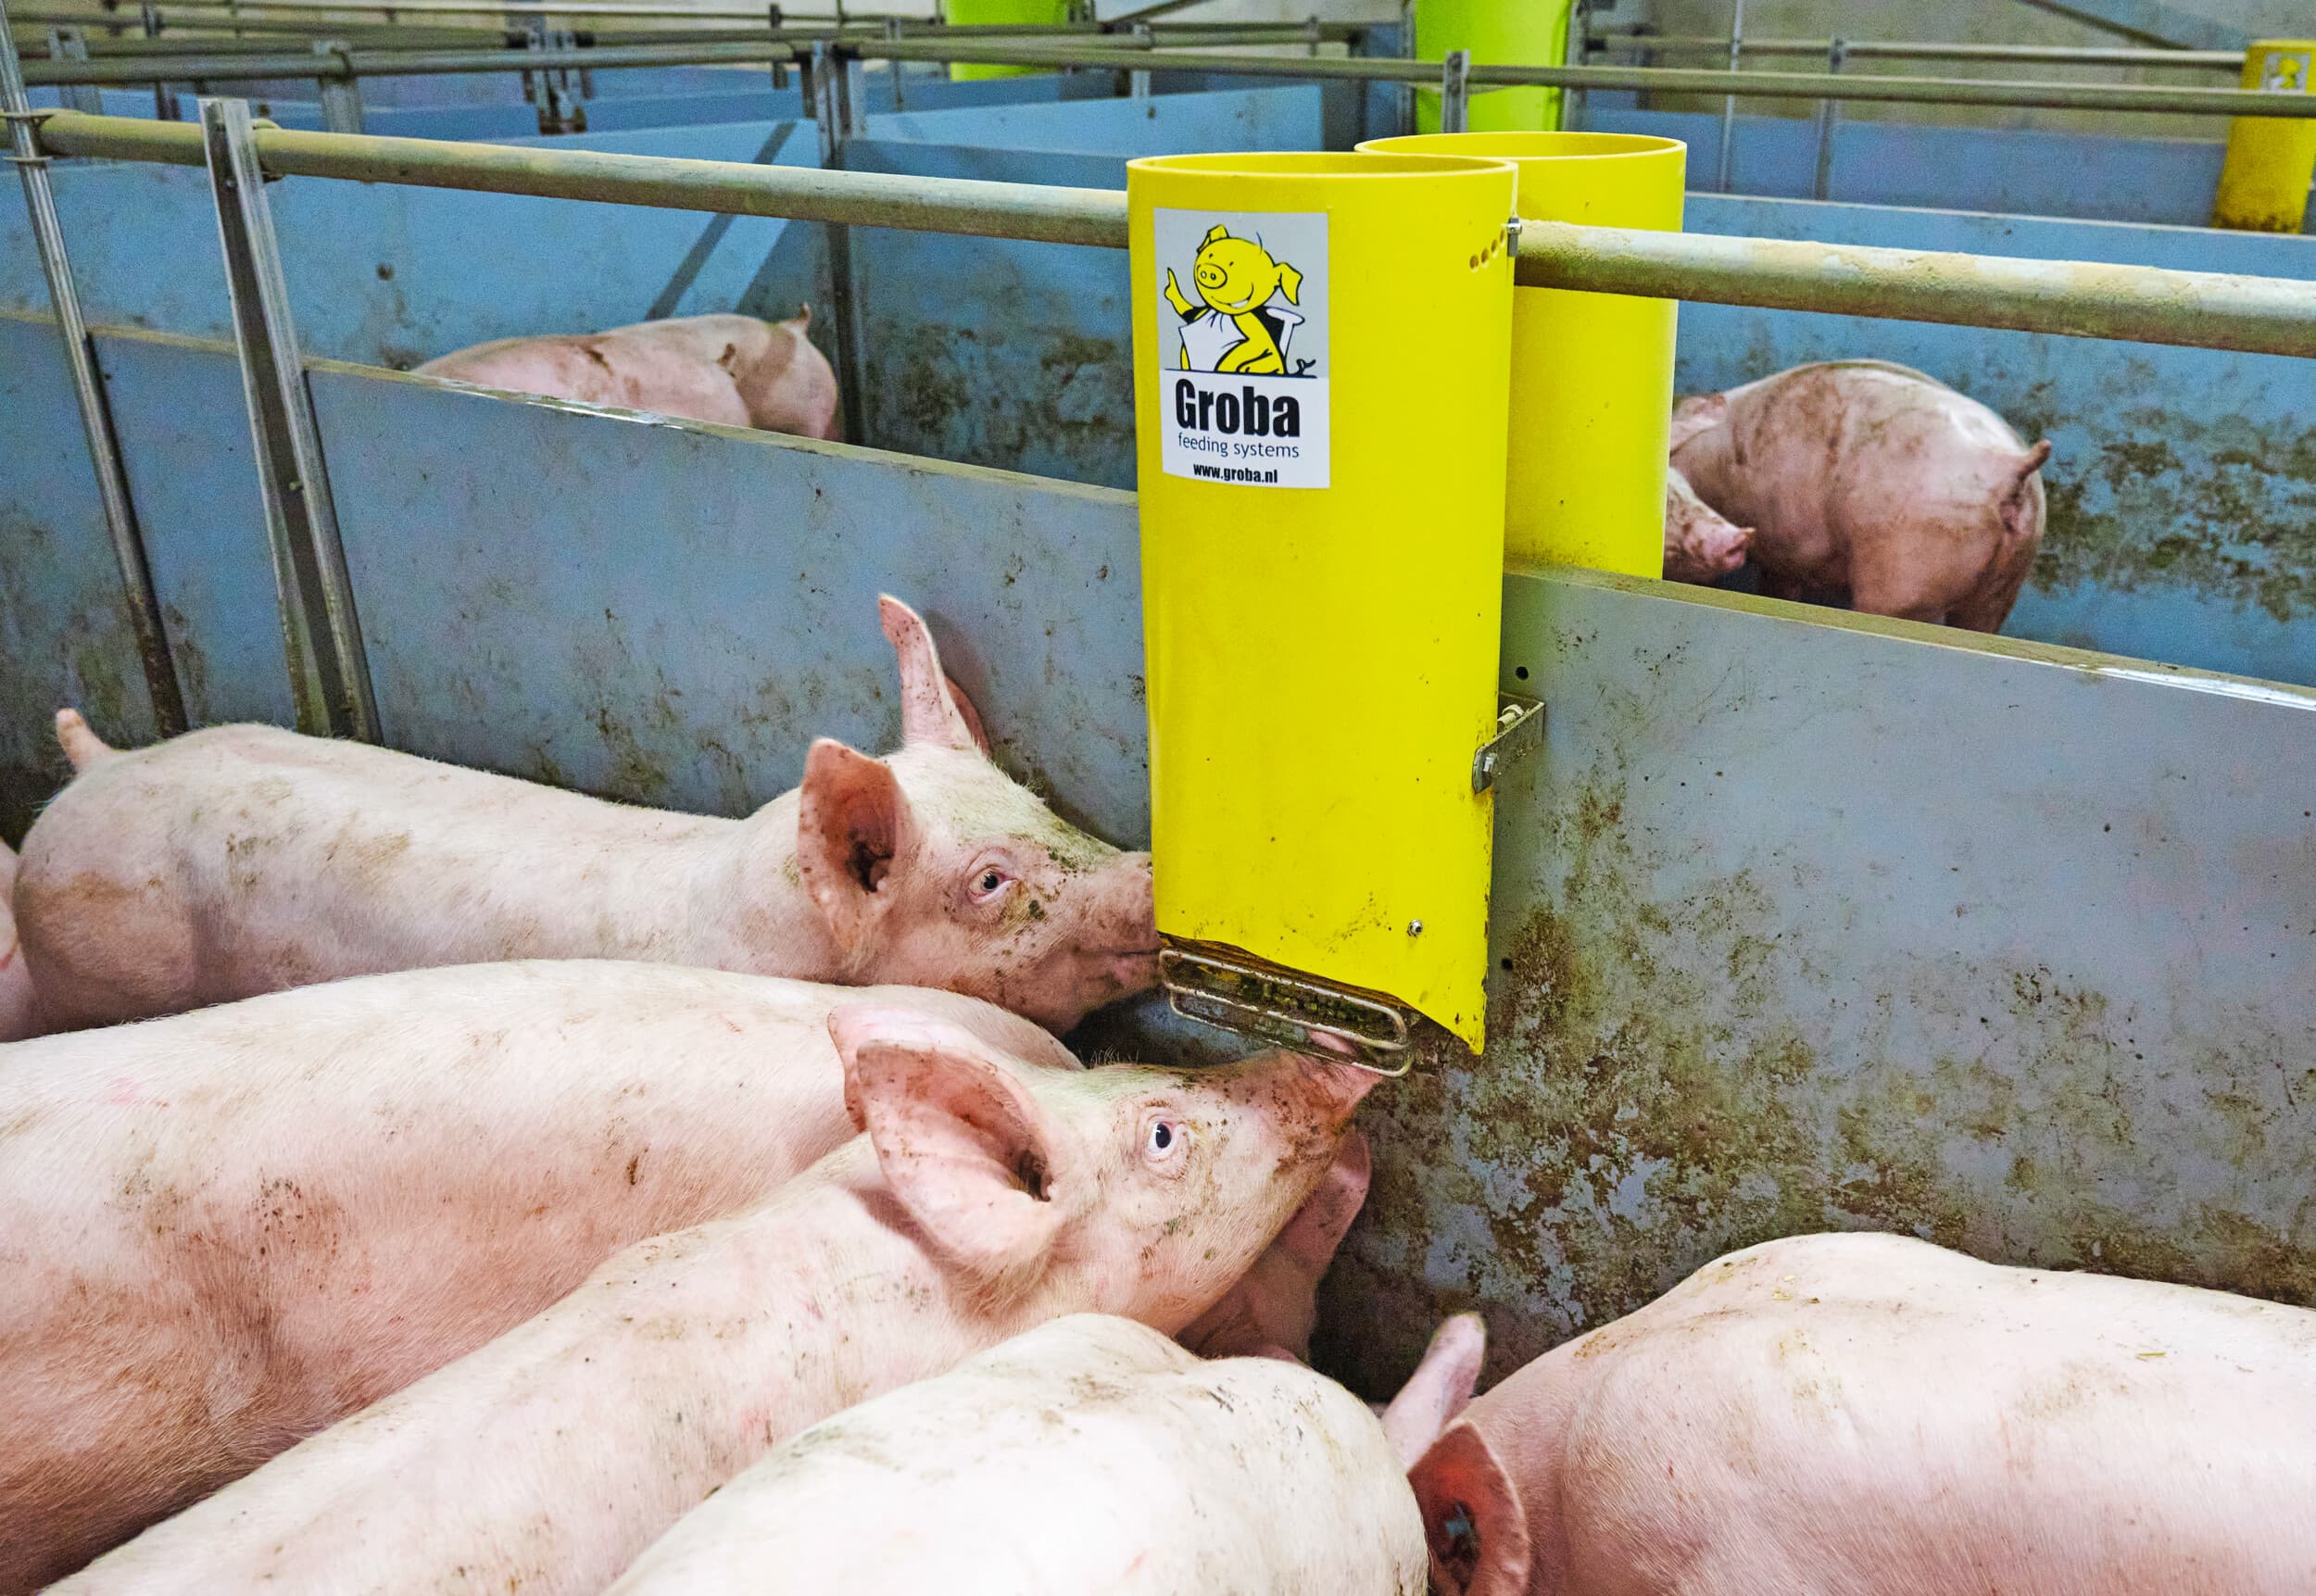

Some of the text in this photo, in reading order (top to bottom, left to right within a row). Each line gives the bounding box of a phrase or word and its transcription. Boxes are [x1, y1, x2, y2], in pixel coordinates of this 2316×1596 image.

[1176, 378, 1300, 437] Groba
[1177, 433, 1299, 459] feeding systems
[1193, 463, 1278, 483] www.groba.nl
